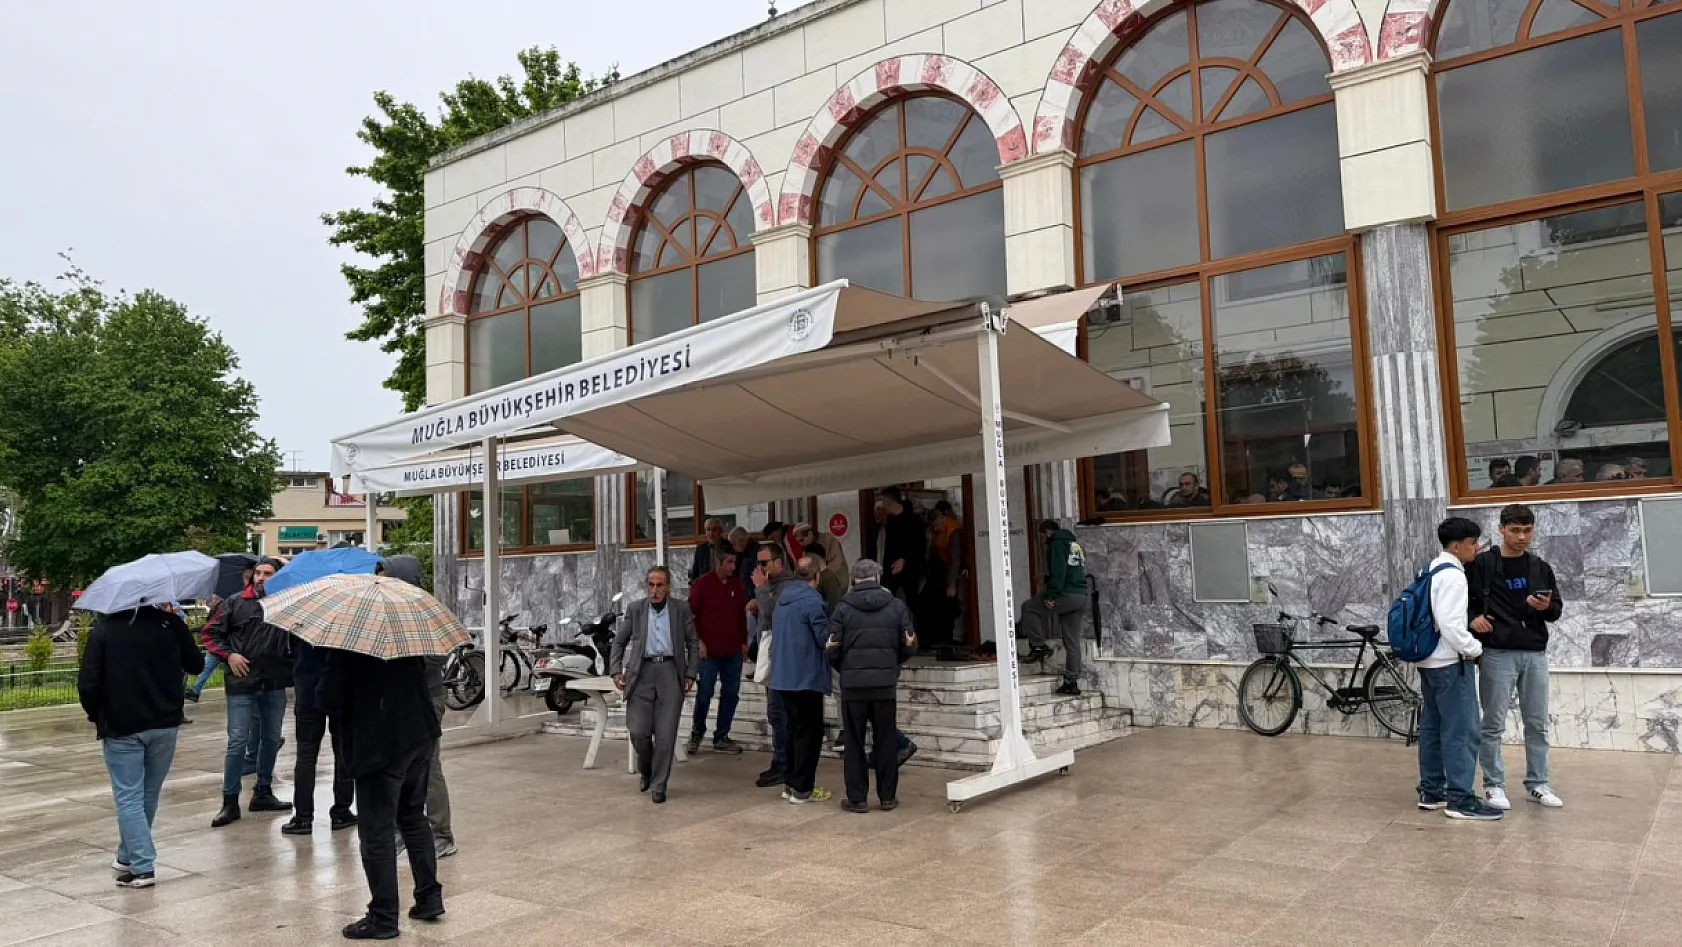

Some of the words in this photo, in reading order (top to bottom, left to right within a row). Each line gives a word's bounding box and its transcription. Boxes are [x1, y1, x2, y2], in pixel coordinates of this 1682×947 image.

[412, 415, 464, 445] MUĞLA
[468, 381, 574, 429] BÜYÜKŞEHİR
[580, 343, 690, 398] BELEDİYESİ
[403, 468, 436, 482] MUĞLA
[438, 461, 500, 479] BÜYÜKŞER
[504, 450, 565, 471] BELEDİYESİ
